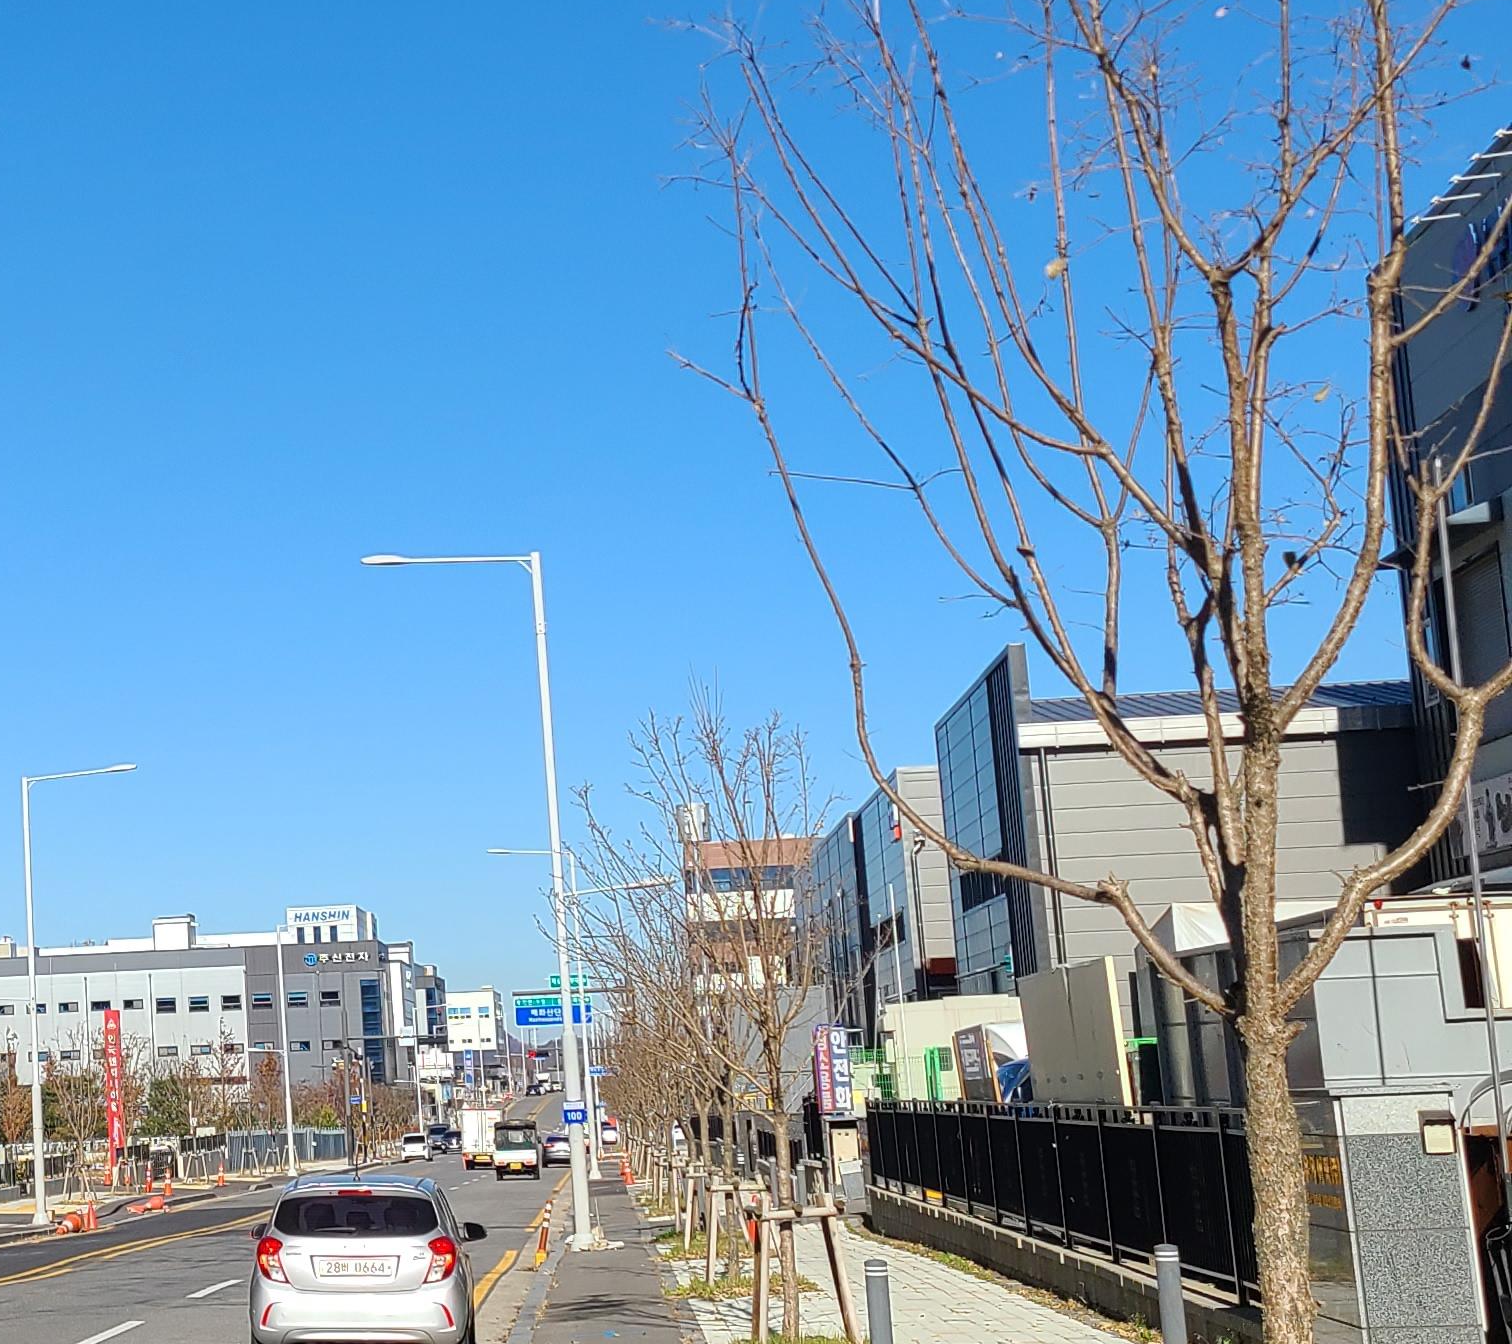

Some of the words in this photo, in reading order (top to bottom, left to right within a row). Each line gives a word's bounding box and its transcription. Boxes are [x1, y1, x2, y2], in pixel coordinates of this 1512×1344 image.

[294, 910, 350, 923] HANSHIN
[830, 1030, 851, 1109] 안전화
[567, 1111, 583, 1121] 100
[354, 1262, 385, 1274] 0664
